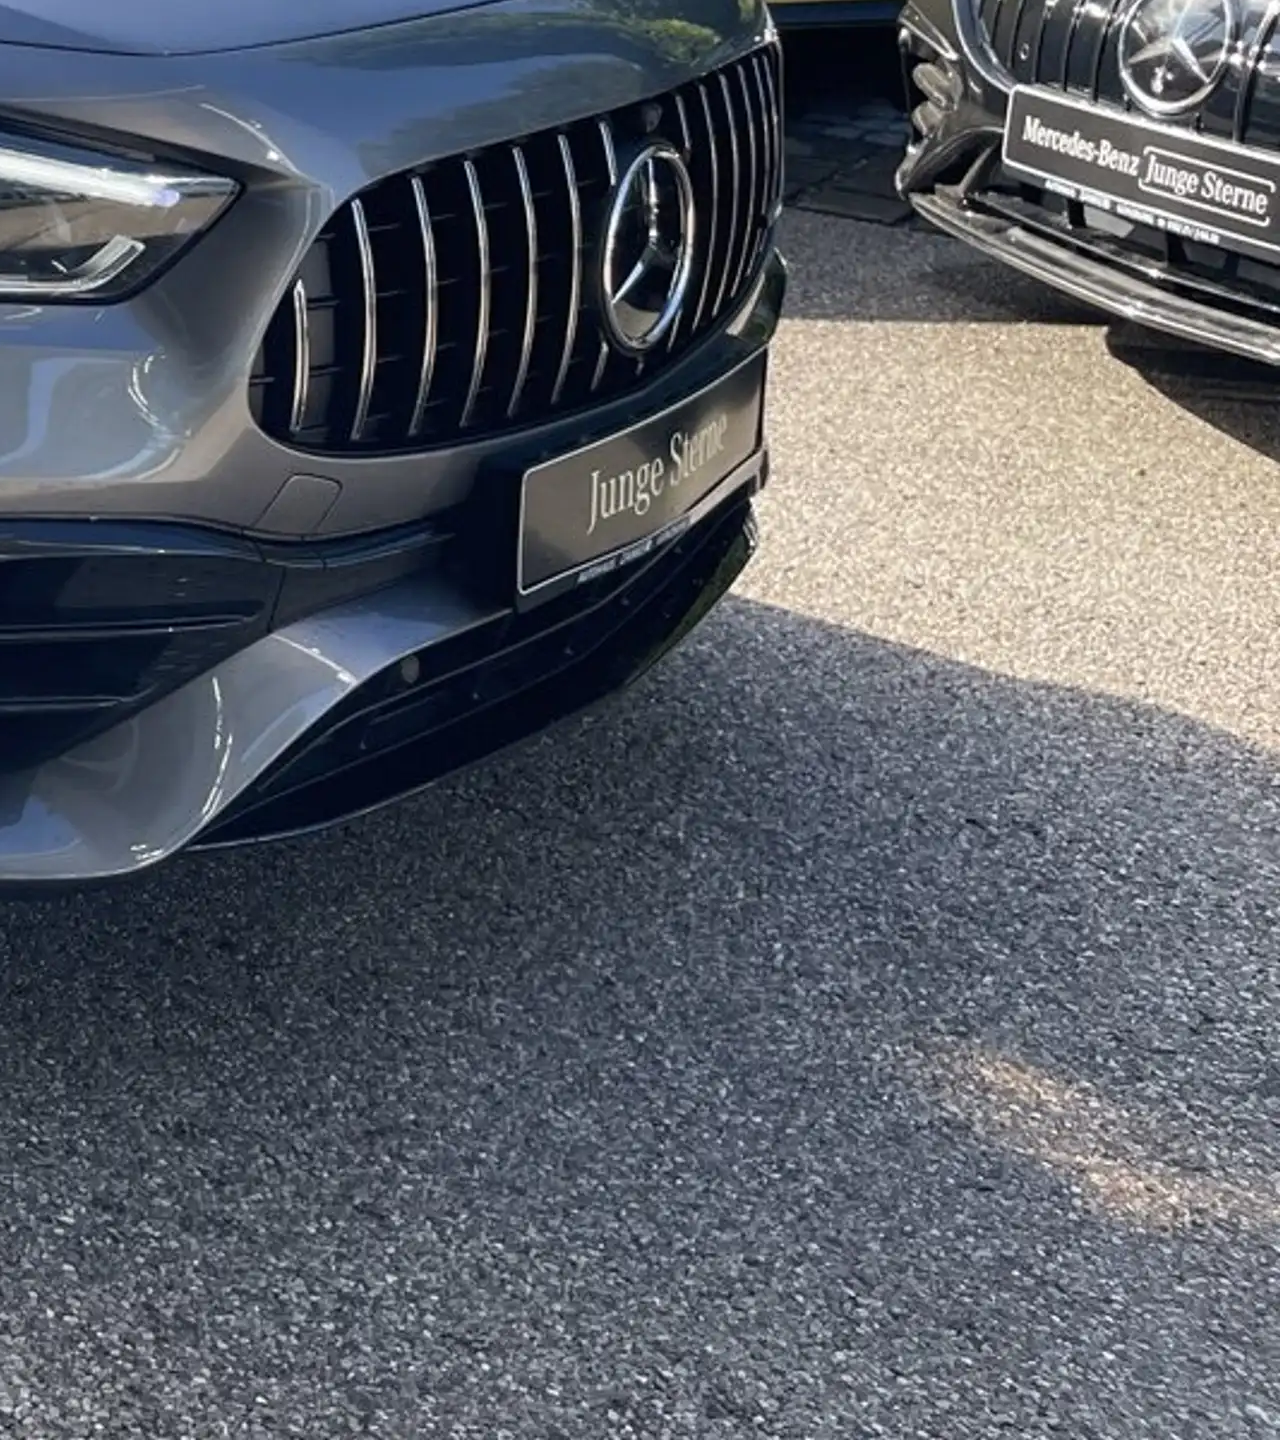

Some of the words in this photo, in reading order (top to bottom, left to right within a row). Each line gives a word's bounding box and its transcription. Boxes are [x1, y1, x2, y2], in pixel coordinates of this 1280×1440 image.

[1022, 116, 1140, 175] Mercedes-Benz
[1145, 156, 1200, 195] Junge
[1200, 170, 1268, 216] Sterne
[587, 457, 665, 535] Junge
[669, 415, 728, 486] Sterne
